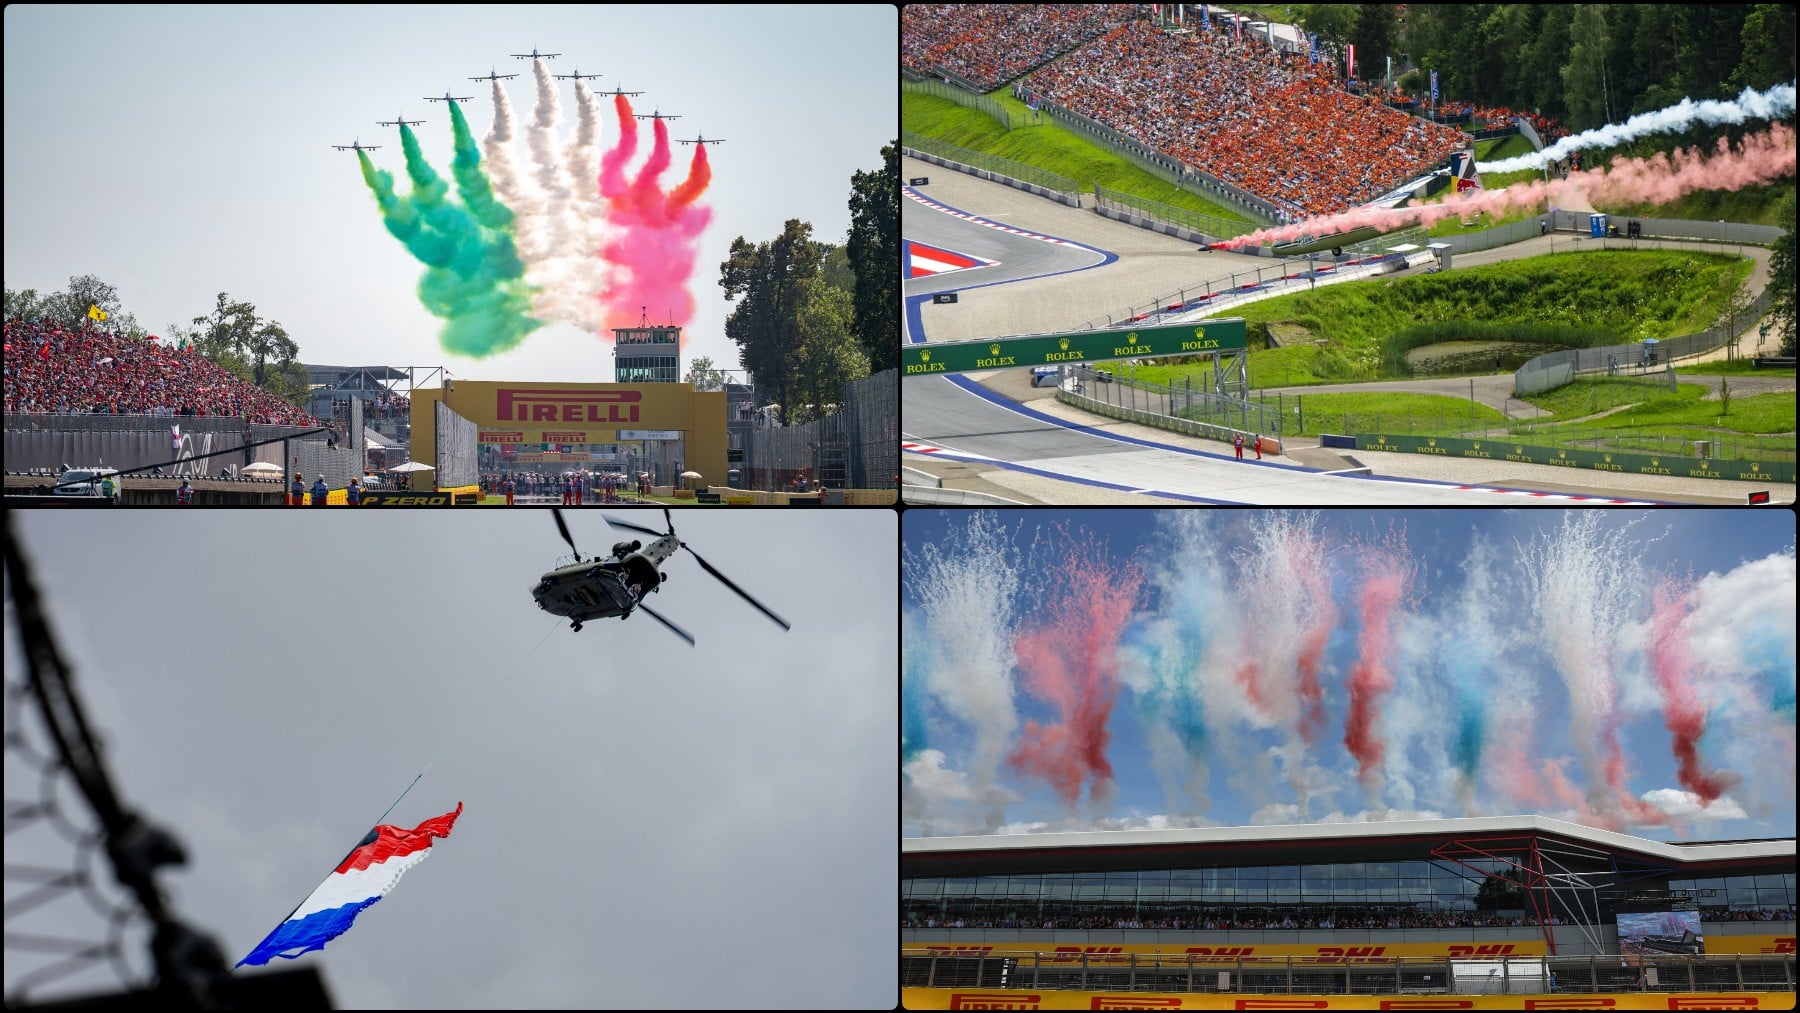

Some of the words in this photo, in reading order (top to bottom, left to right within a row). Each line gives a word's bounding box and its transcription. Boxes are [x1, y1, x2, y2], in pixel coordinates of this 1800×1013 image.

[1114, 344, 1152, 356] ROLEX
[1182, 339, 1220, 350] ROLEX
[976, 355, 1016, 368] ROLEX
[1046, 350, 1084, 362] ROLEX
[906, 361, 946, 374] ROLEX
[497, 389, 642, 422] PIRELLI
[479, 431, 524, 442] PIRELLI
[542, 431, 586, 442] PIRELLI
[1366, 443, 1398, 452] ROLEX
[1417, 447, 1447, 455] ROLEX
[1464, 450, 1490, 458] ROLEX
[1506, 453, 1533, 463] ROLEX
[1549, 458, 1577, 467] ROLEX
[1594, 462, 1623, 471] ROLEX
[1641, 466, 1671, 475] ROLEX
[1689, 469, 1720, 478] ROLEX
[1740, 472, 1772, 481] ROLEX
[361, 496, 379, 505] P
[382, 496, 446, 505] ZERO
[1181, 947, 1258, 963] DHL
[1316, 946, 1390, 963] DHL
[1447, 944, 1519, 960] DHL
